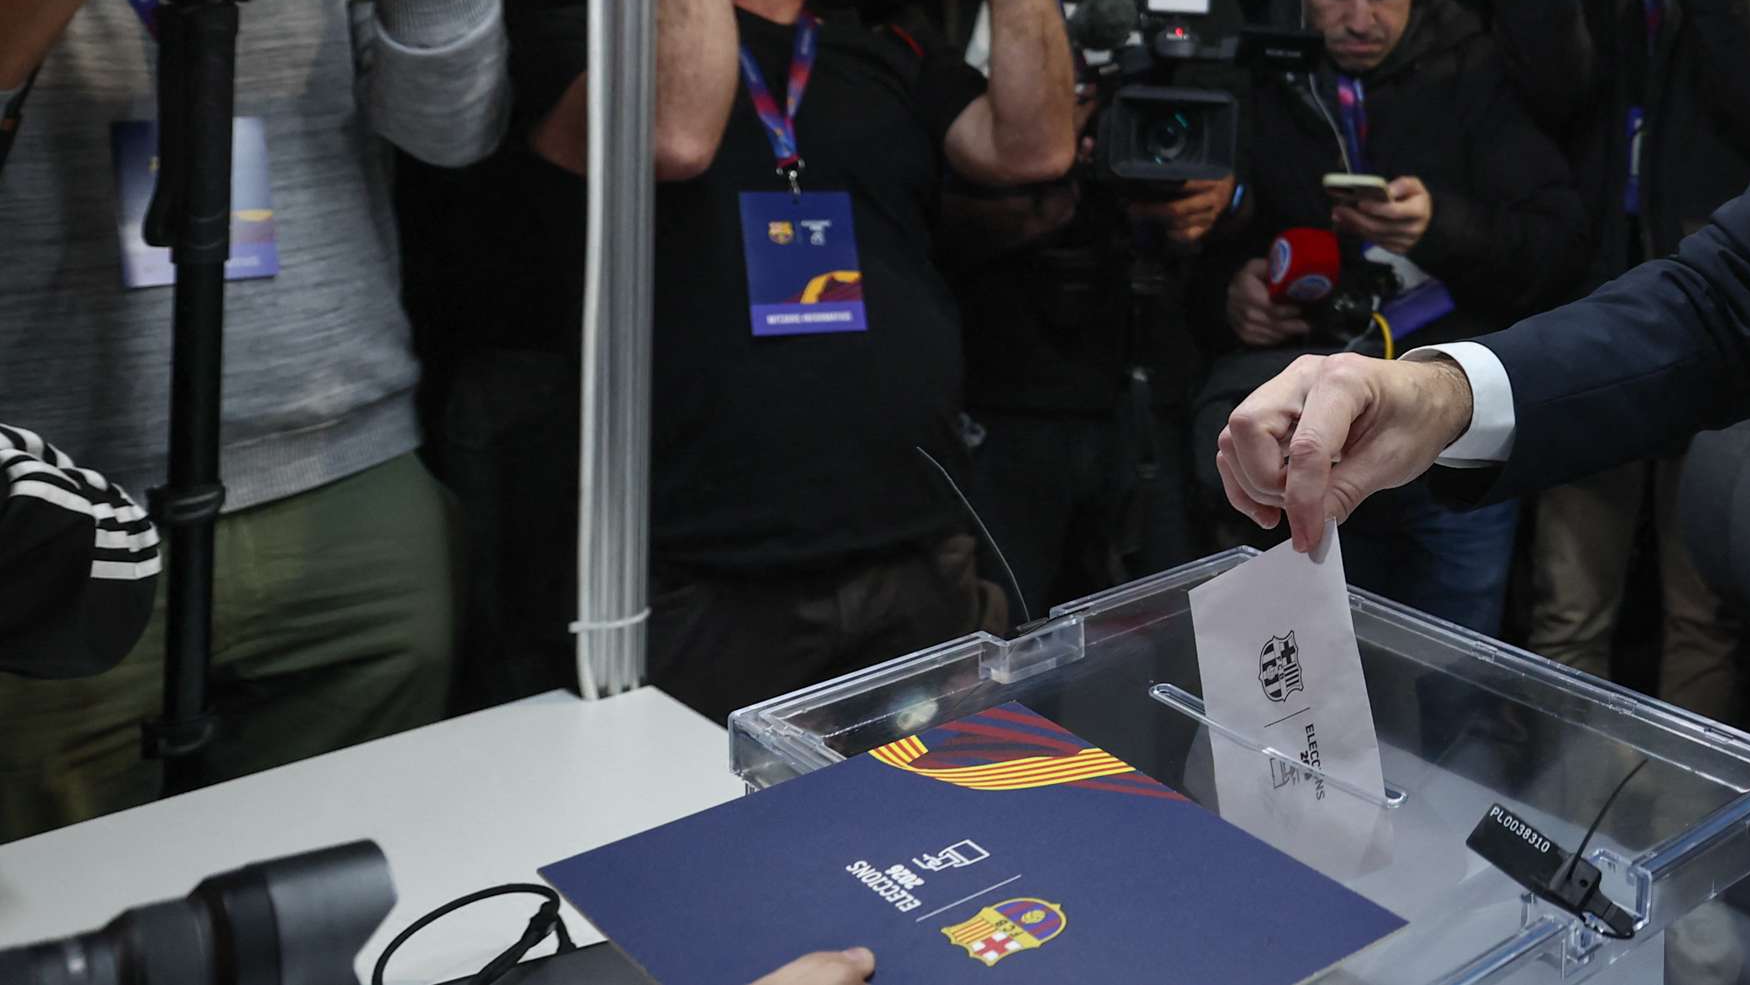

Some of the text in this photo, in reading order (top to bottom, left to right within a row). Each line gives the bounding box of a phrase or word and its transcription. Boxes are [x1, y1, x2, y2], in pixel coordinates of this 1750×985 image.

[1304, 723, 1325, 801] ELECCNS
[1490, 806, 1551, 853] PL0038310
[846, 860, 922, 912] ELECCIONS
[885, 864, 925, 890] 2026
